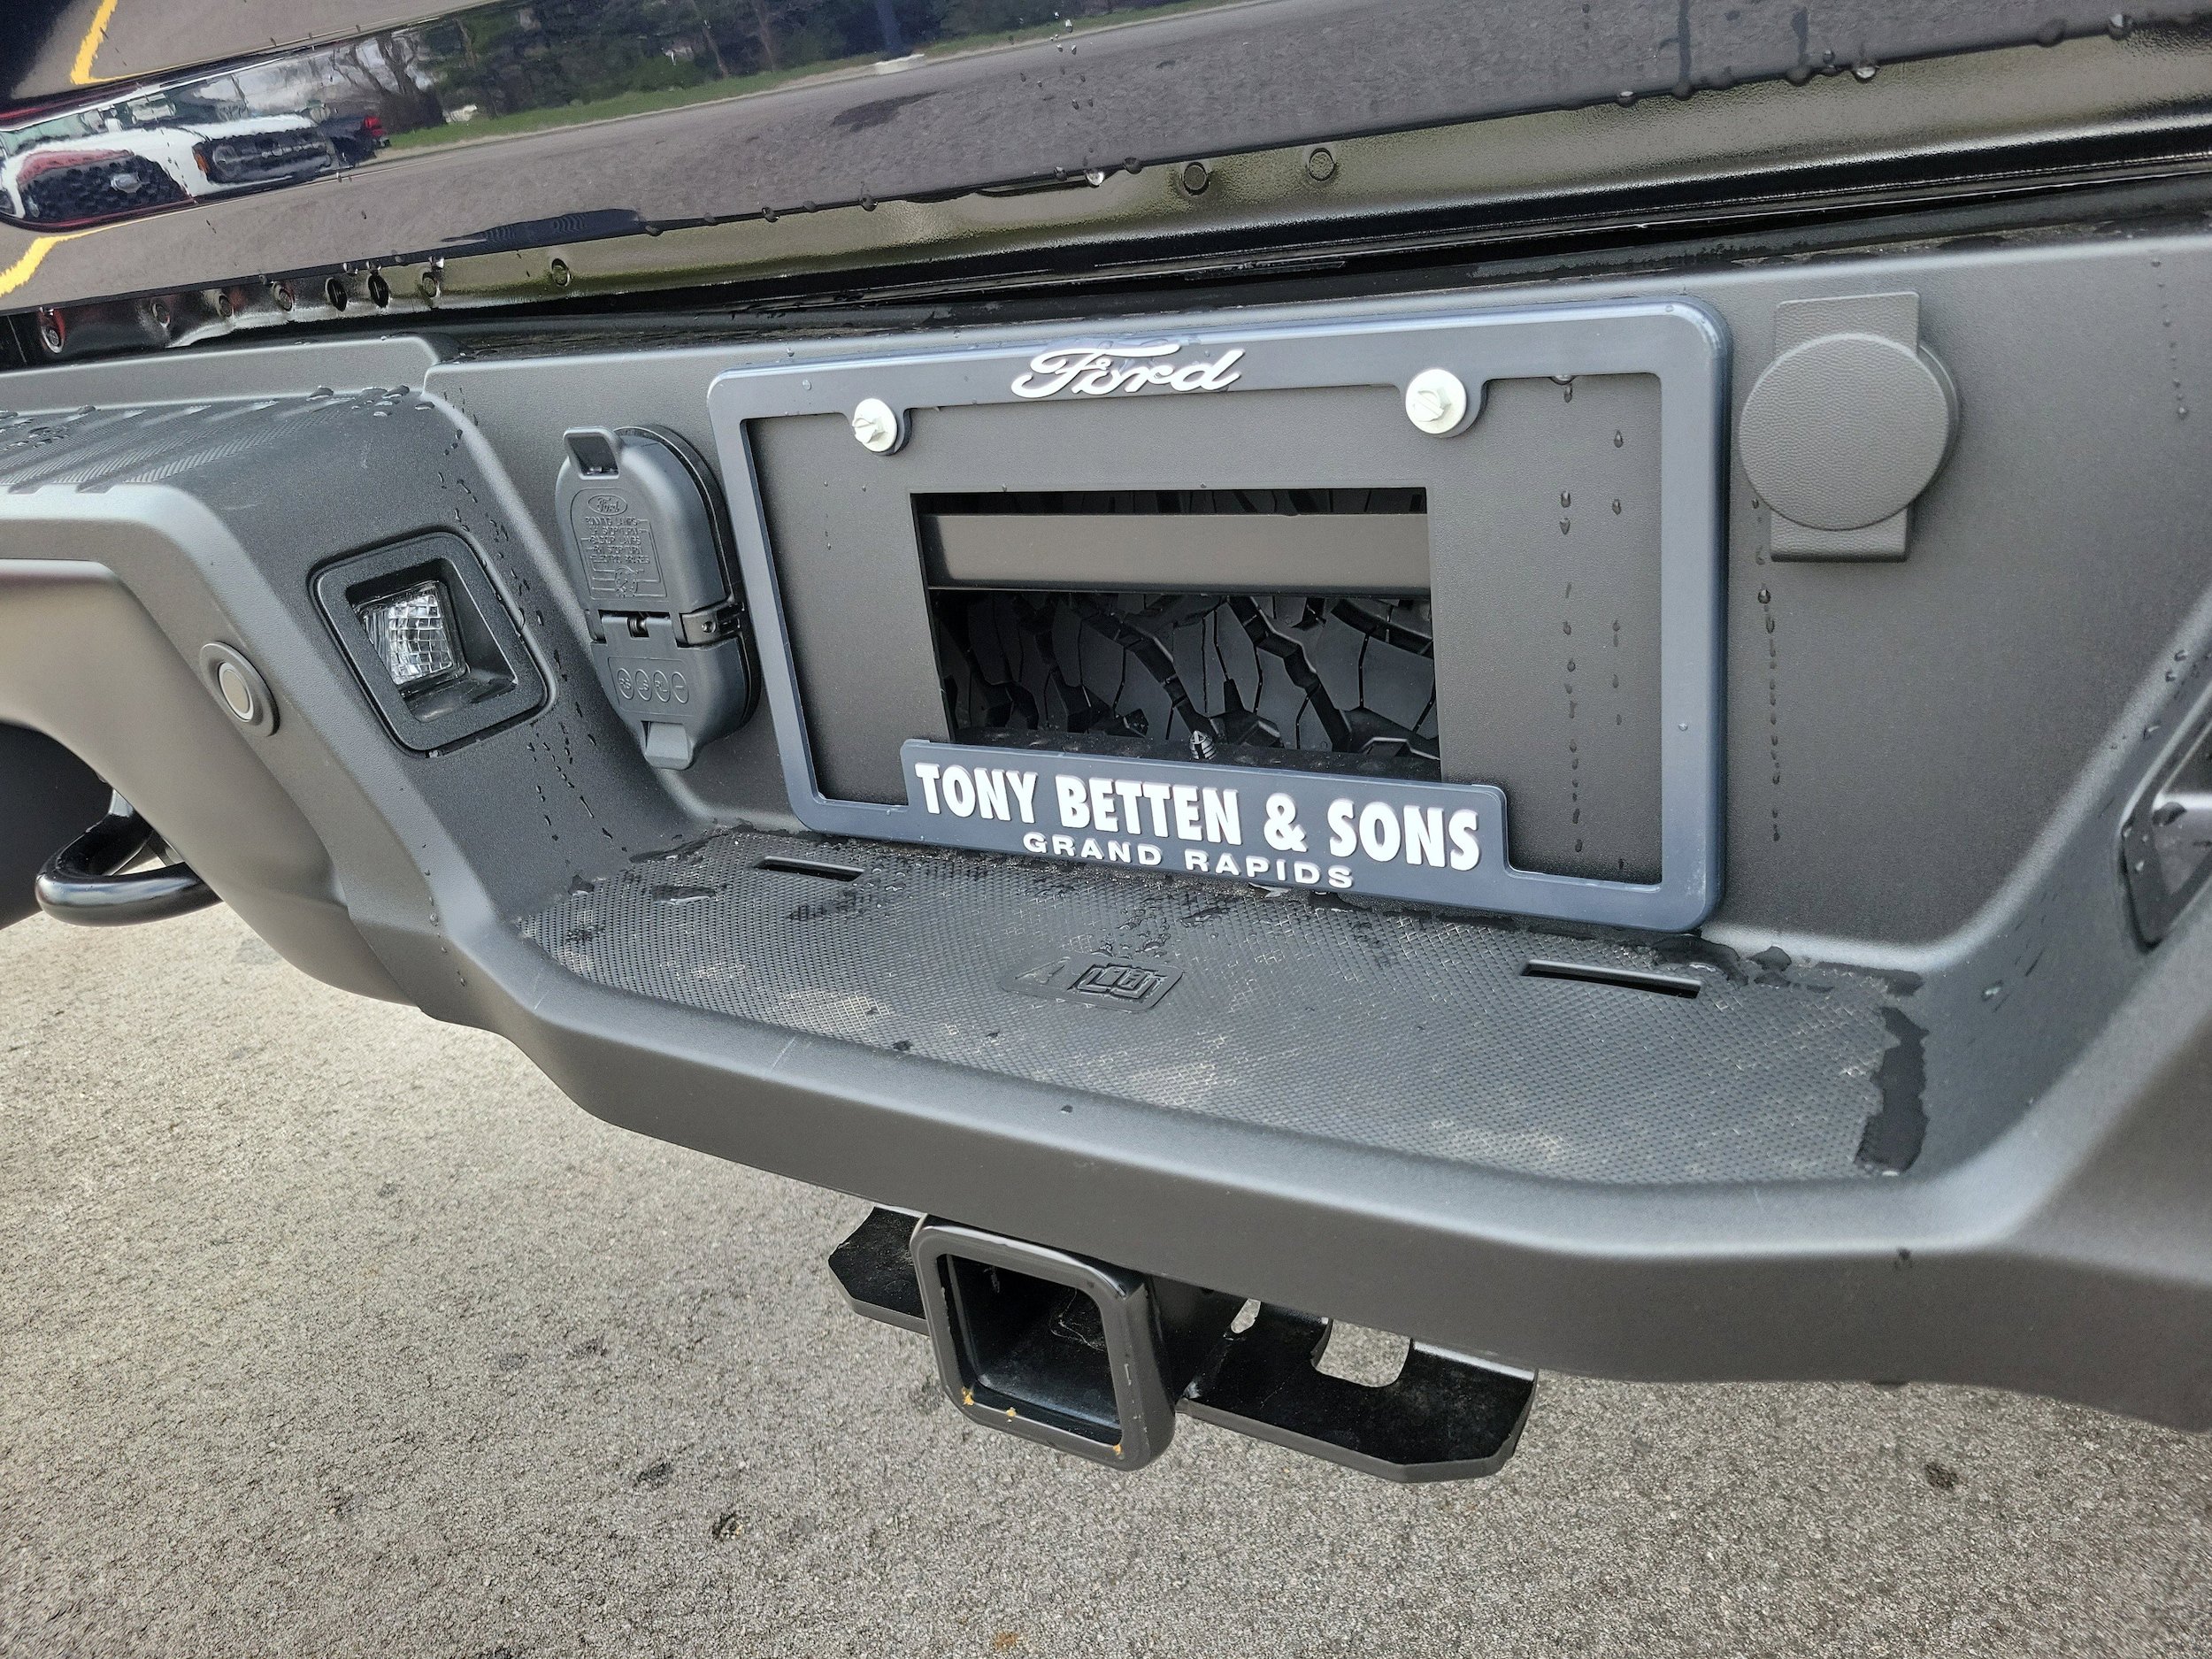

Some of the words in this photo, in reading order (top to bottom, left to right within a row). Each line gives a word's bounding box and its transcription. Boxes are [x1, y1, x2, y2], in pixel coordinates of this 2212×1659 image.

[1010, 343, 1245, 398] Ford
[597, 496, 620, 512] Ford
[915, 762, 1038, 824] TONY
[1055, 774, 1242, 845] BETTEN
[1263, 793, 1308, 853] &
[1327, 798, 1480, 871] SONS
[1023, 832, 1163, 866] GRAND
[1184, 849, 1354, 888] RAPIDS
